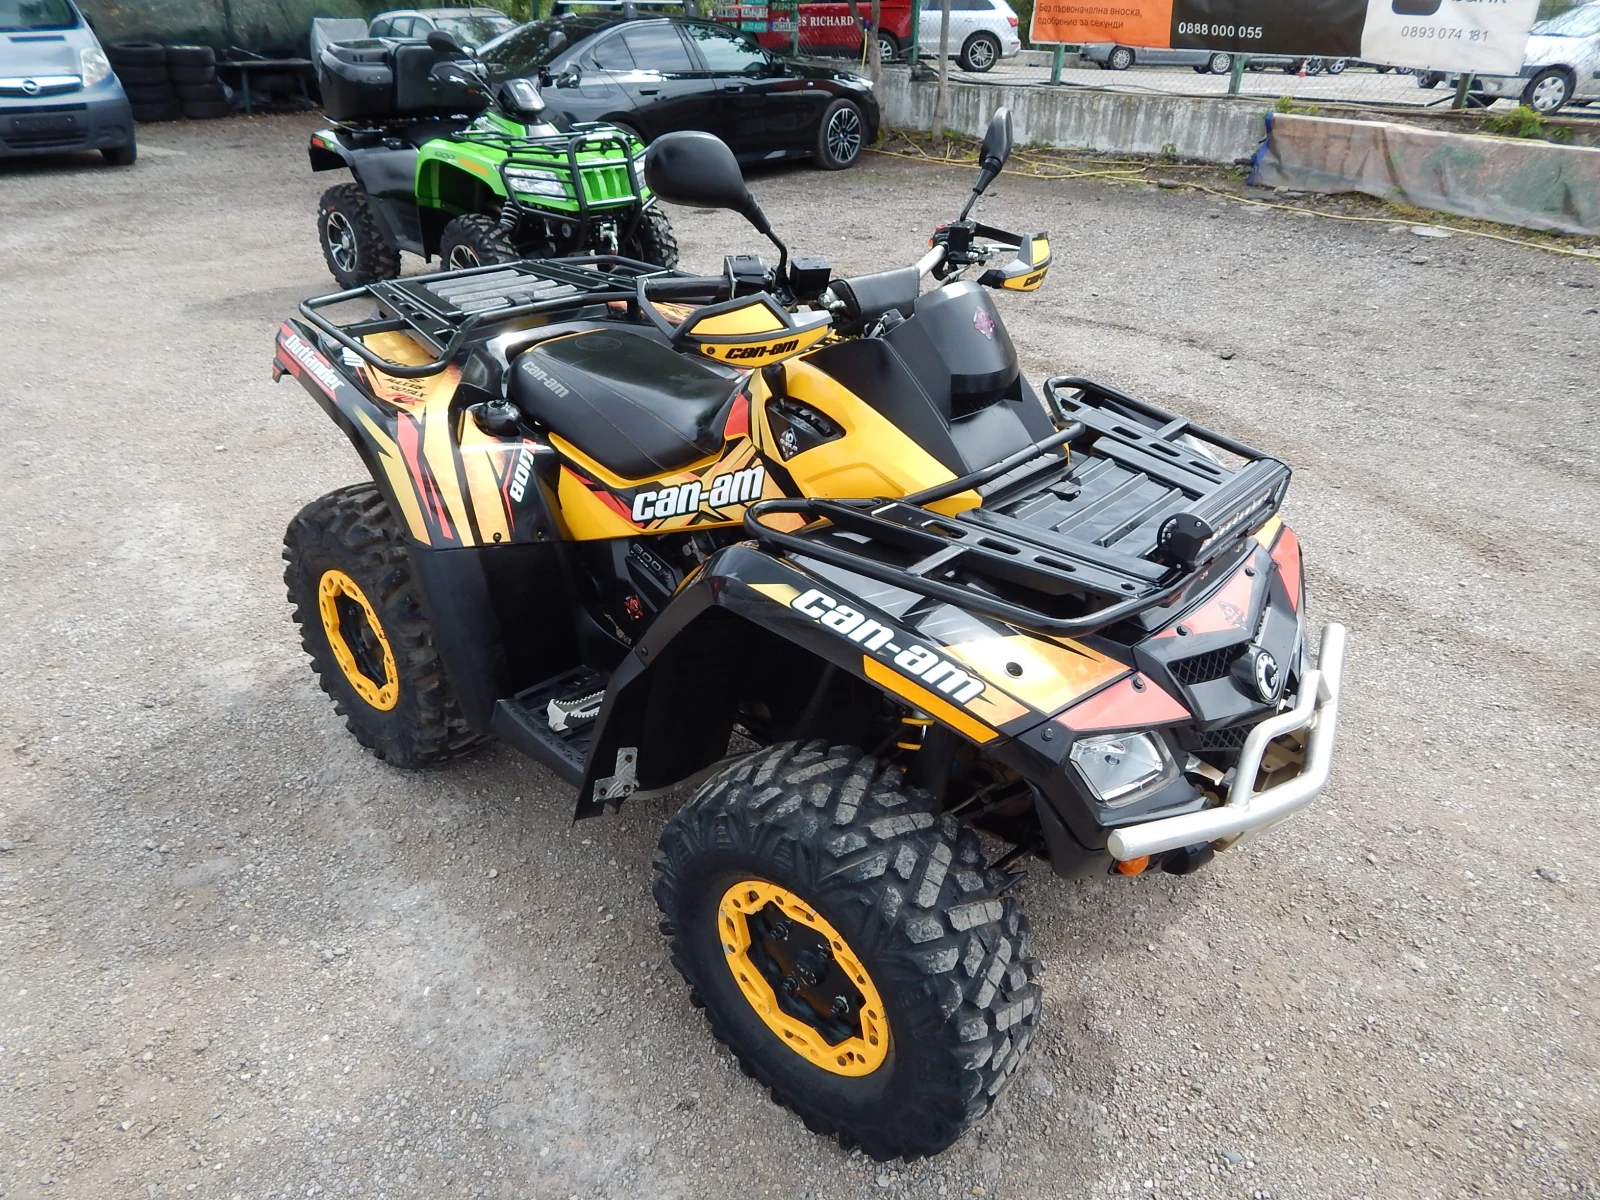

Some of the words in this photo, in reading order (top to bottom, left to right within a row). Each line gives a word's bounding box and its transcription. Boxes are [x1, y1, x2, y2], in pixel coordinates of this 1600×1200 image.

[1038, 3, 1052, 12] Без
[1053, 5, 1108, 15] първоначална
[1109, 8, 1142, 17] вноска,
[810, 15, 855, 27] RICHARD
[1037, 16, 1078, 26] одобрение
[1090, 20, 1124, 29] секунди
[1178, 22, 1208, 35] 0888
[1211, 24, 1235, 37] 000
[1238, 26, 1262, 39] 055
[1401, 26, 1434, 39] 0893
[1438, 27, 1463, 40] 074
[1468, 30, 1489, 42] 181
[724, 339, 800, 359] can-am
[284, 334, 345, 391] Outlander
[521, 360, 570, 399] can-am
[632, 465, 766, 522] can-am
[791, 588, 986, 704] can-am
